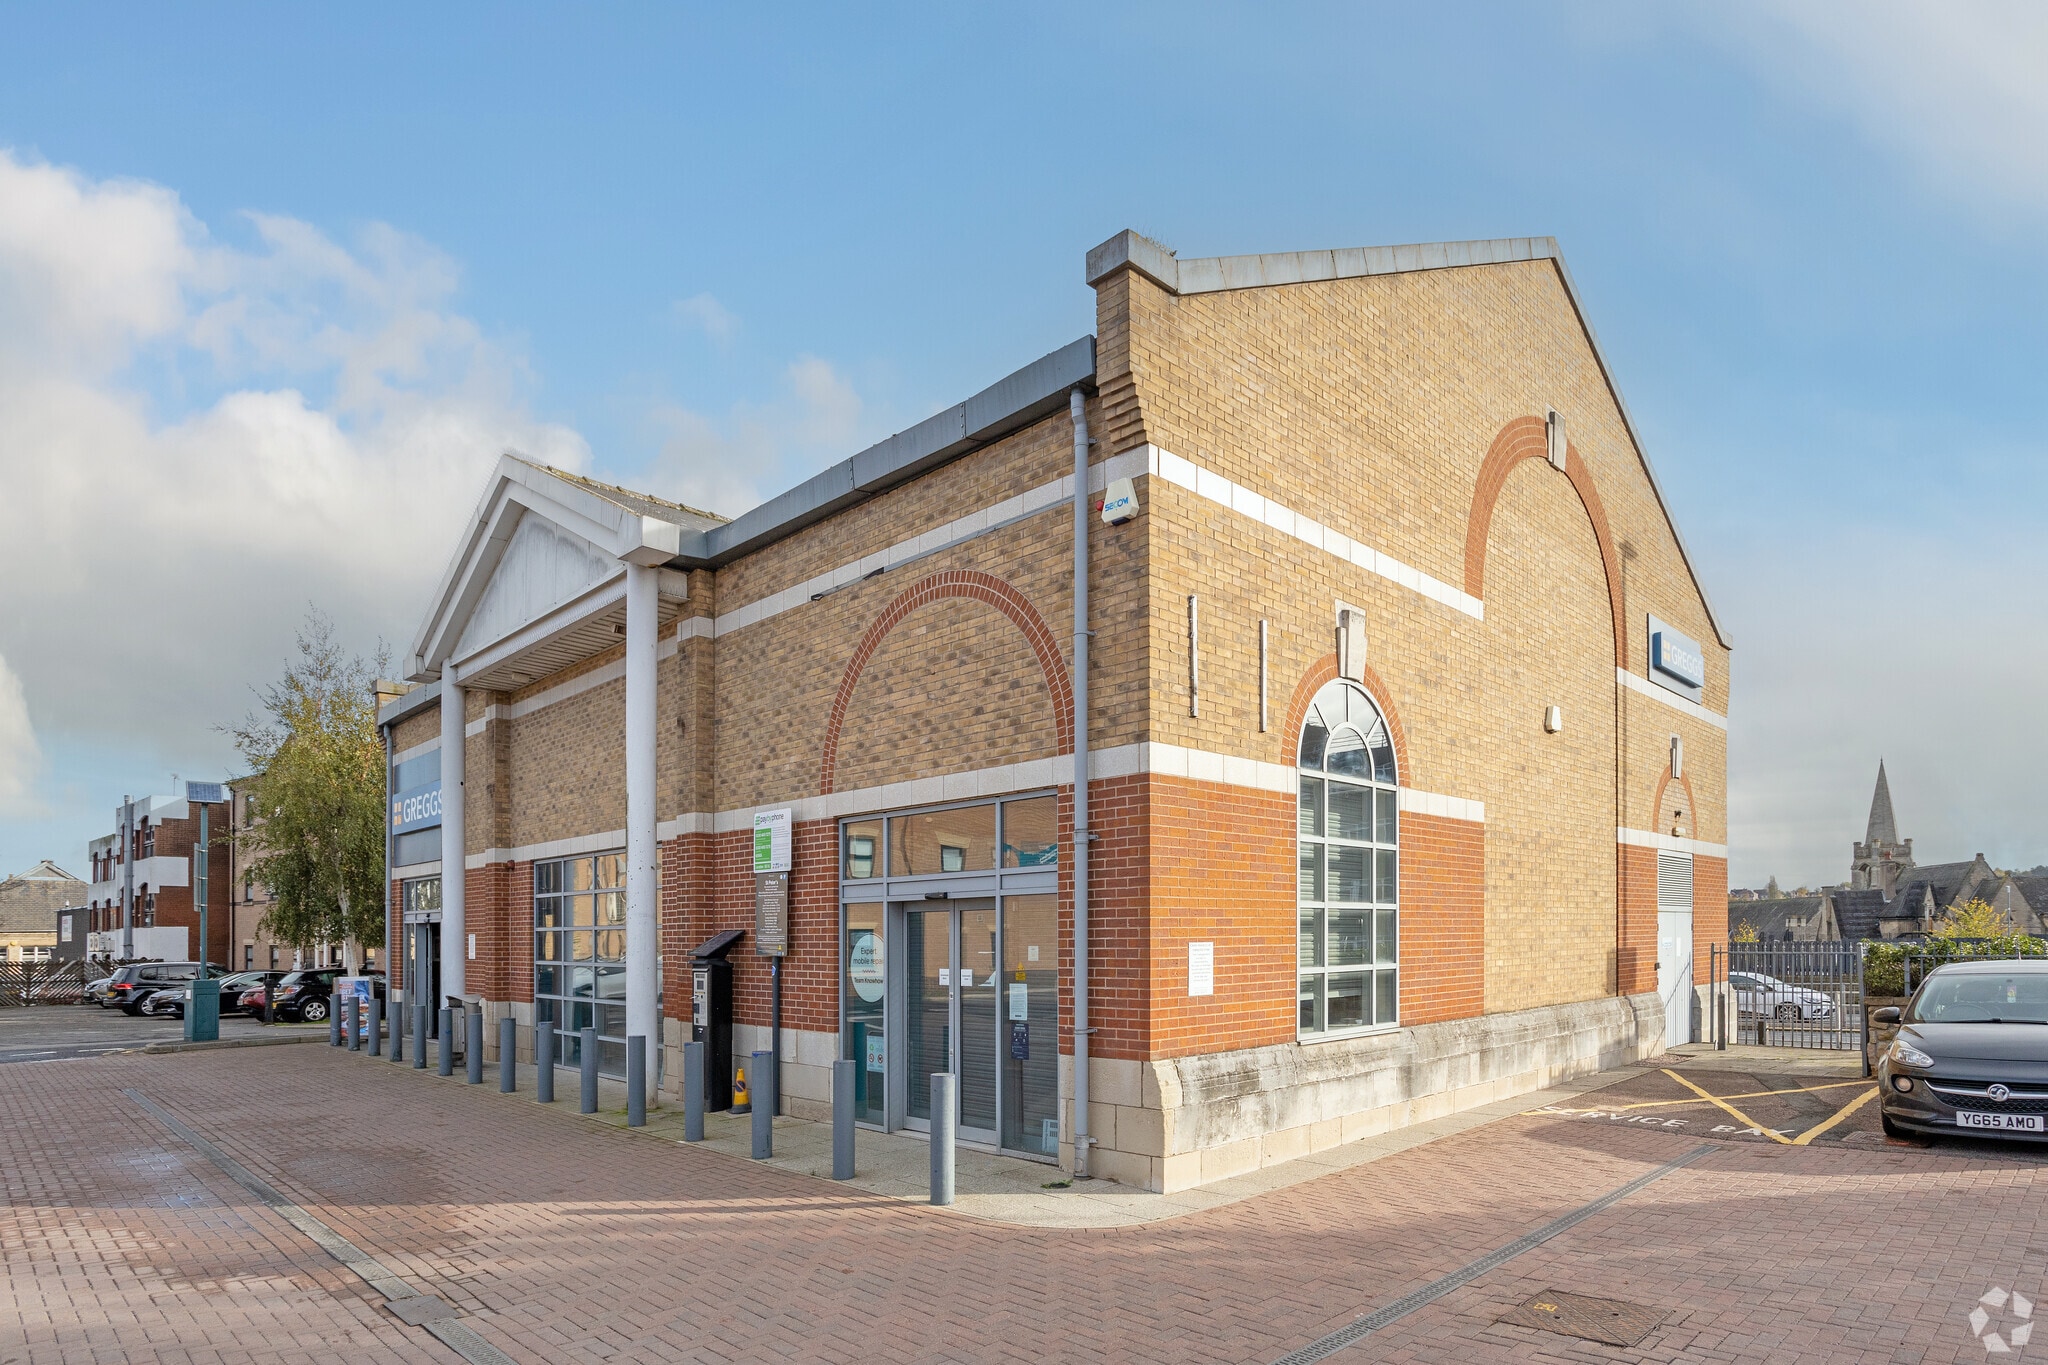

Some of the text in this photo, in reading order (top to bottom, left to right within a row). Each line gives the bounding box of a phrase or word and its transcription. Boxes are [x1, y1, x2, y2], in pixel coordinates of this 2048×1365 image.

[1671, 645, 1702, 678] GREGGS
[860, 947, 877, 956] Expert
[853, 957, 870, 965] mobile
[1963, 1113, 2035, 1129] YG65 AMO
